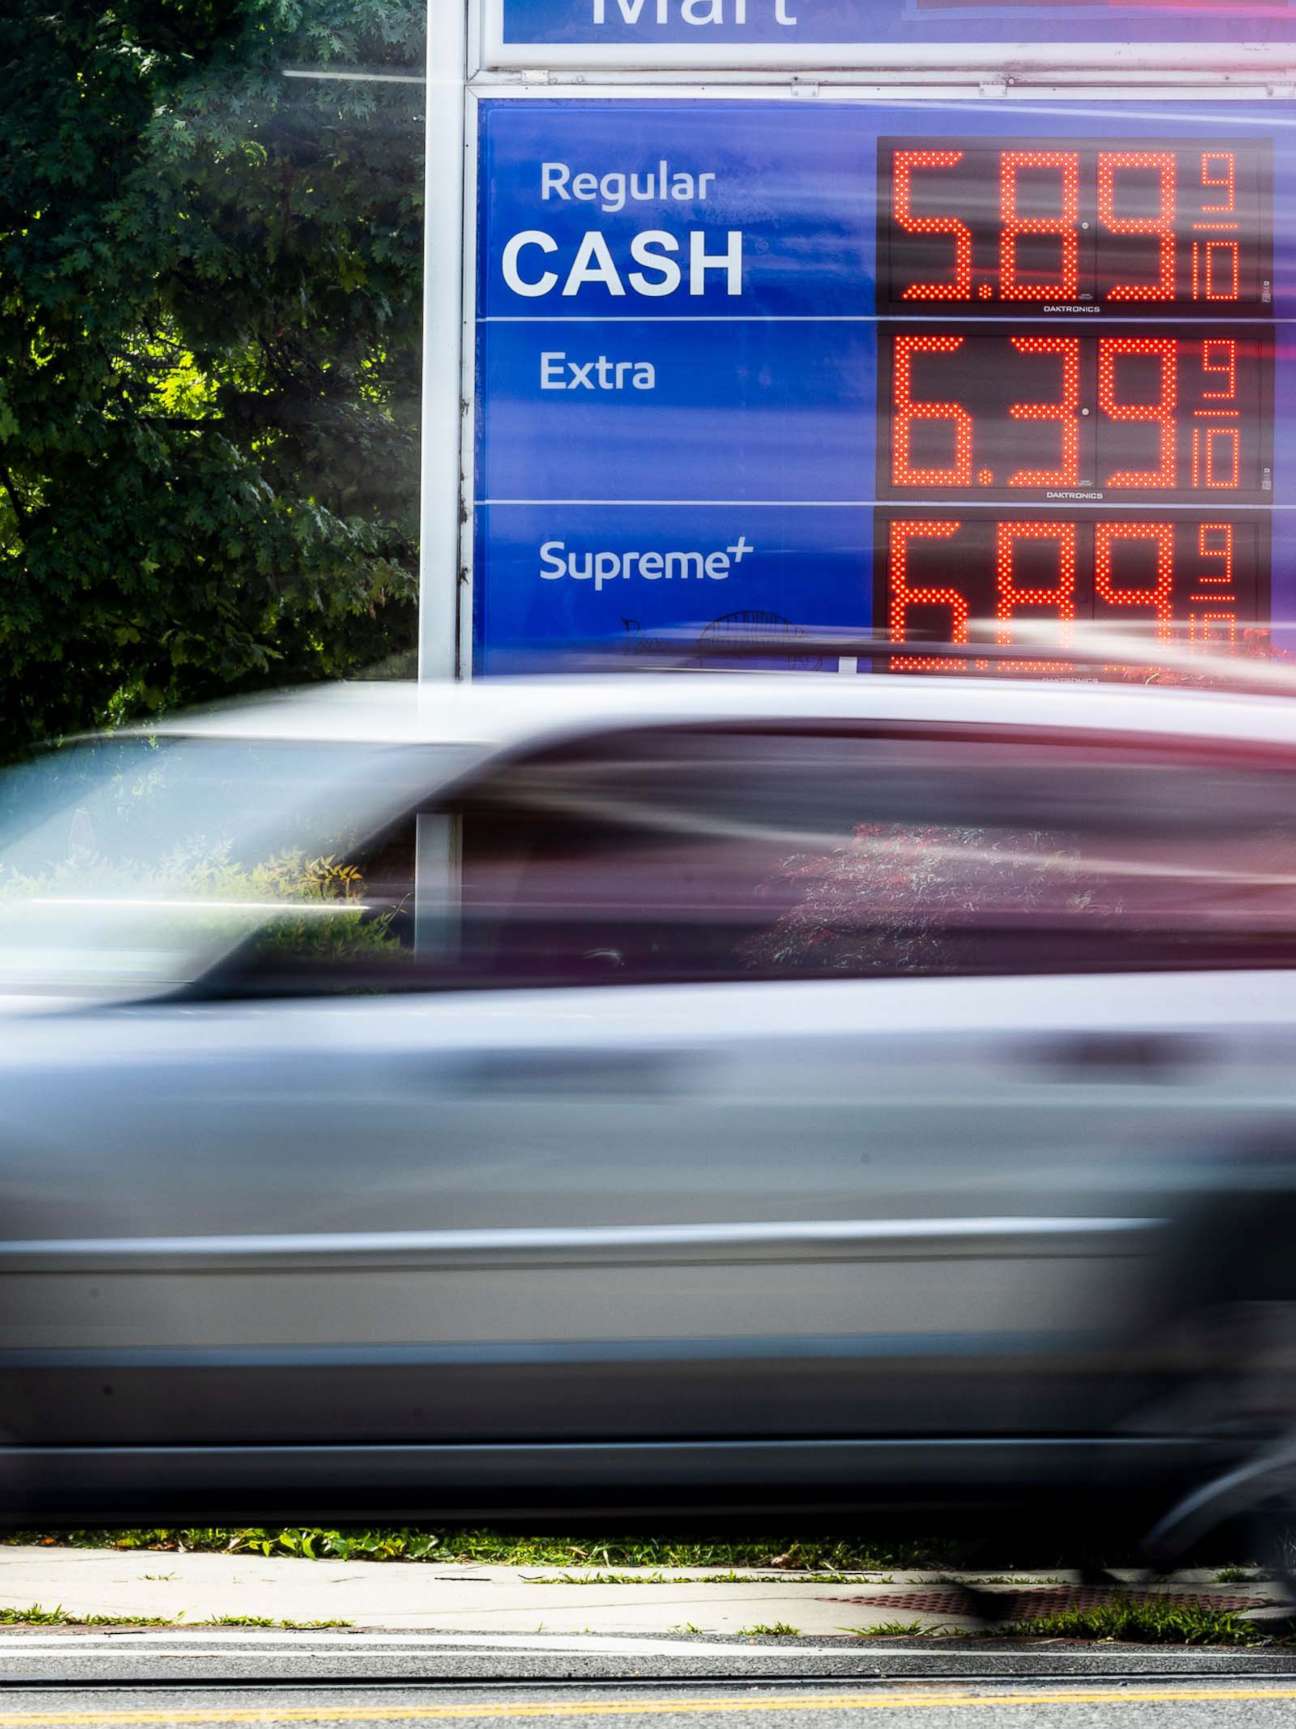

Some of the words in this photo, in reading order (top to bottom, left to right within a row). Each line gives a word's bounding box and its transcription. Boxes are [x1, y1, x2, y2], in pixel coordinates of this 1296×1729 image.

[541, 160, 716, 213] Regular
[893, 151, 1176, 301] 5.89
[502, 230, 743, 297] CASH
[1043, 305, 1100, 313] DAKTRONICS
[540, 352, 656, 390] Extra
[893, 337, 1176, 487] 6.39
[1046, 491, 1103, 500] DAKTRONICS
